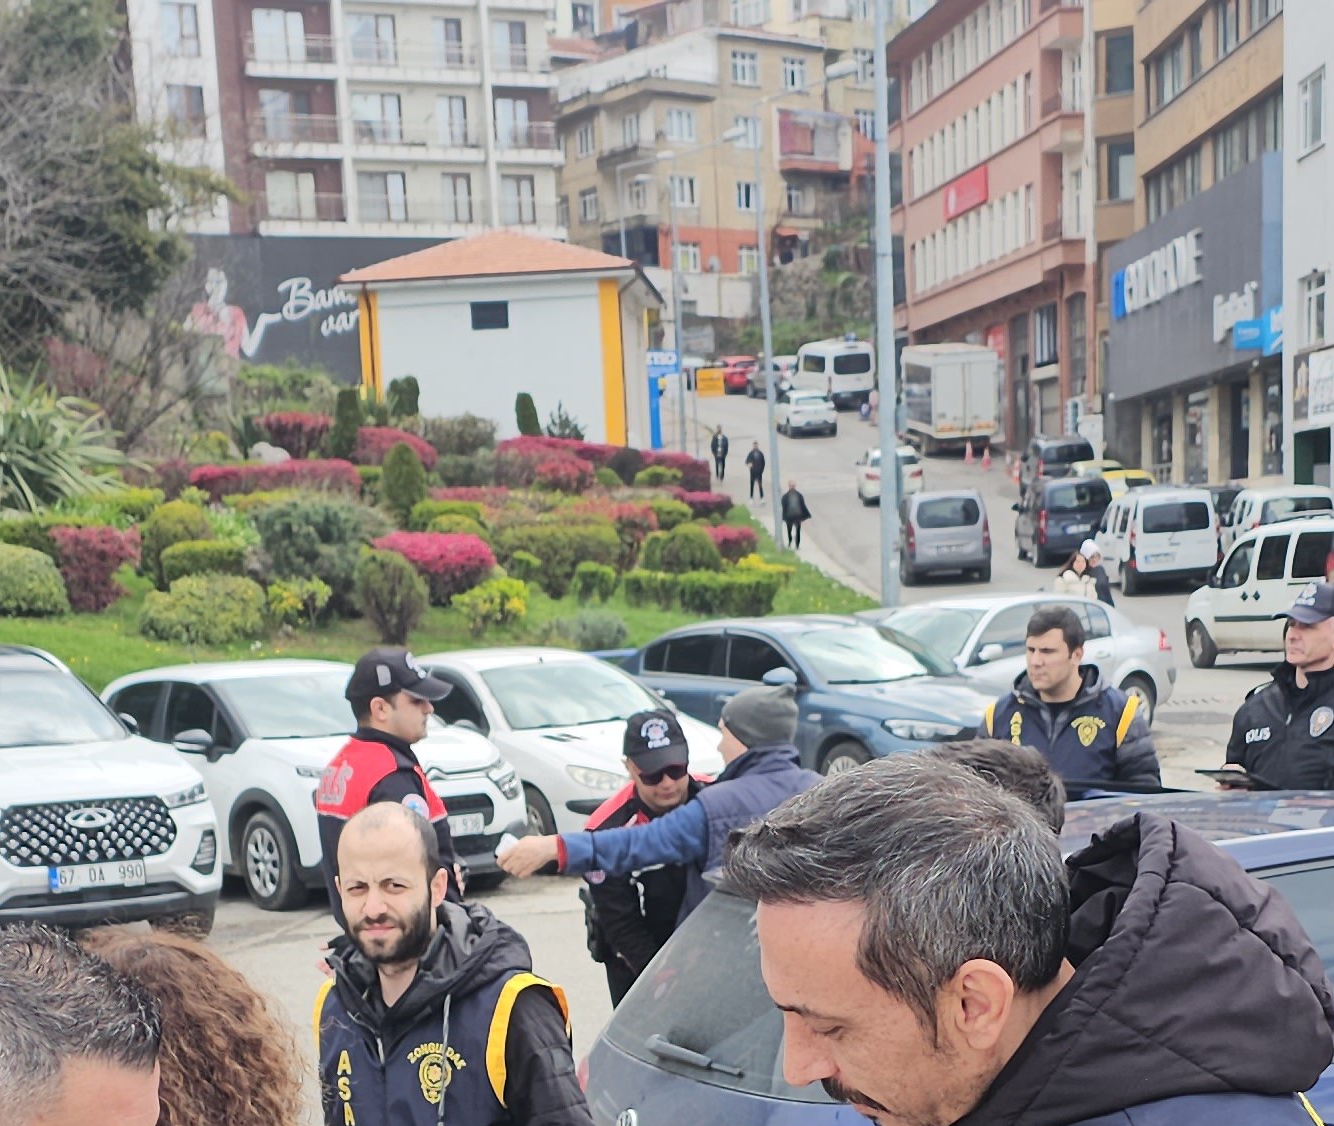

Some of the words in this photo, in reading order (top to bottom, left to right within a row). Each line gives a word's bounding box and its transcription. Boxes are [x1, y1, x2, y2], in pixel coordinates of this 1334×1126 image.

[59, 869, 75, 885] 67
[118, 863, 143, 879] 990
[406, 1042, 467, 1071] ZONGUDAK
